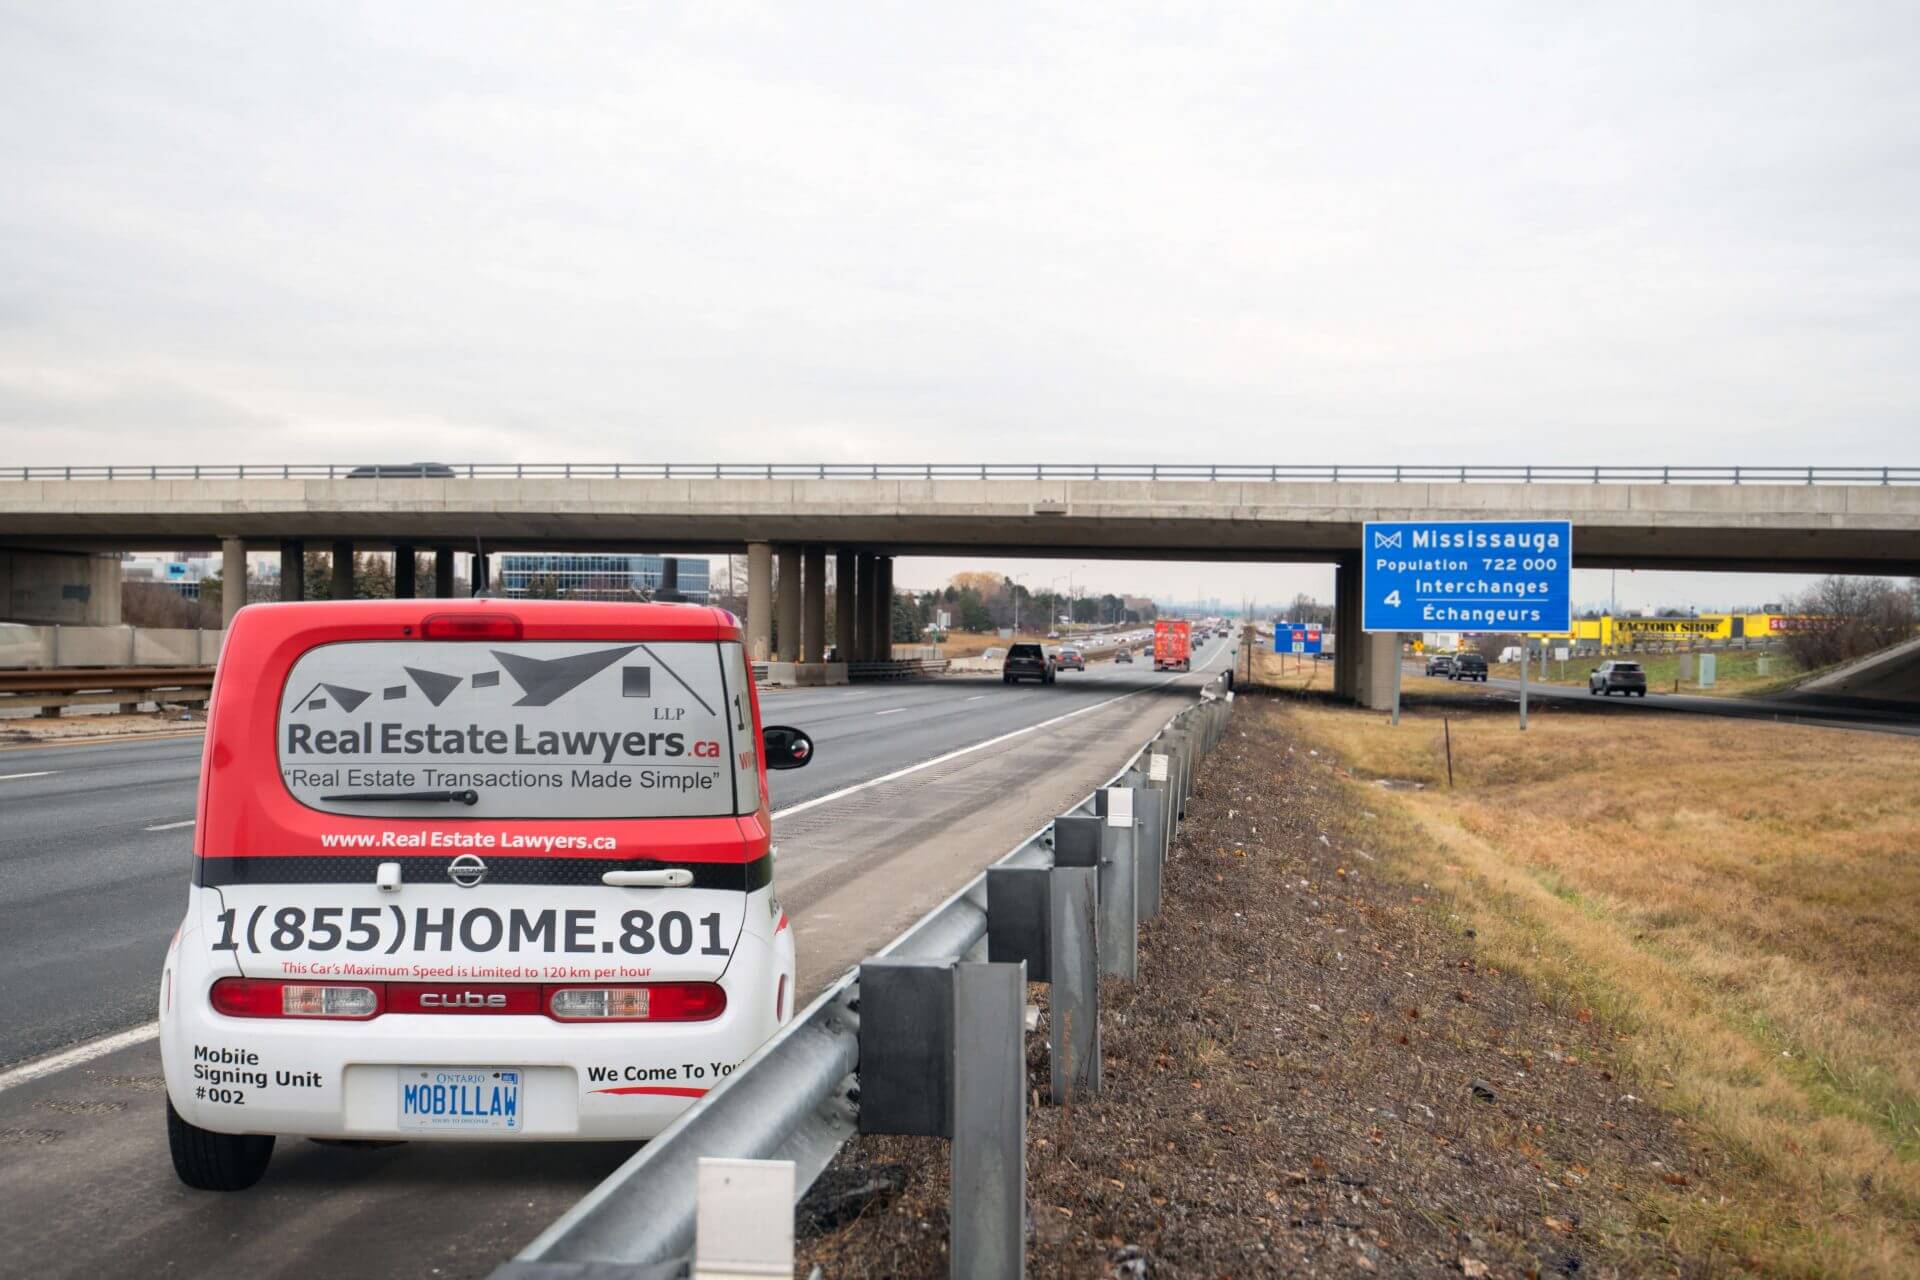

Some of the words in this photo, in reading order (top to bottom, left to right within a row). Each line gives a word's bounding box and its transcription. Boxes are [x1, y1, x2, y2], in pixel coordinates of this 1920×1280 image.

[1412, 529, 1560, 553] Mississauga
[1376, 559, 1468, 573] Population
[1482, 559, 1517, 571] 722
[1522, 559, 1557, 571] 000
[1416, 579, 1549, 597] Interchanges
[1383, 590, 1402, 608] 4
[1423, 603, 1541, 624] Échangeurs
[1618, 621, 1678, 632] FACTORY
[1681, 622, 1720, 633] SHOE
[654, 707, 685, 721] LLP
[348, 768, 415, 787] Estate
[423, 768, 563, 788] Transactions
[571, 770, 632, 788] Made
[431, 831, 496, 848] Estate
[501, 832, 617, 852] Lawyers.ca
[212, 904, 730, 957] 1(855)HOME.801
[282, 962, 308, 974] This
[310, 963, 341, 975] Car’s
[344, 964, 409, 977] Maximum
[412, 965, 454, 980] Speed
[457, 965, 468, 977] is
[471, 966, 522, 978] Limited
[524, 967, 539, 978] to
[543, 966, 567, 978] 120
[570, 965, 590, 978] km
[593, 968, 617, 981] per
[620, 965, 652, 977] hour
[419, 992, 507, 1008] cube
[193, 1064, 268, 1089] Signing
[276, 1071, 322, 1088] Unit
[436, 1072, 485, 1083] ONTARIO
[587, 1067, 618, 1081] We
[624, 1066, 677, 1081] Come
[682, 1063, 705, 1079] To
[195, 1086, 245, 1105] #002
[404, 1084, 517, 1116] MOBILLAW
